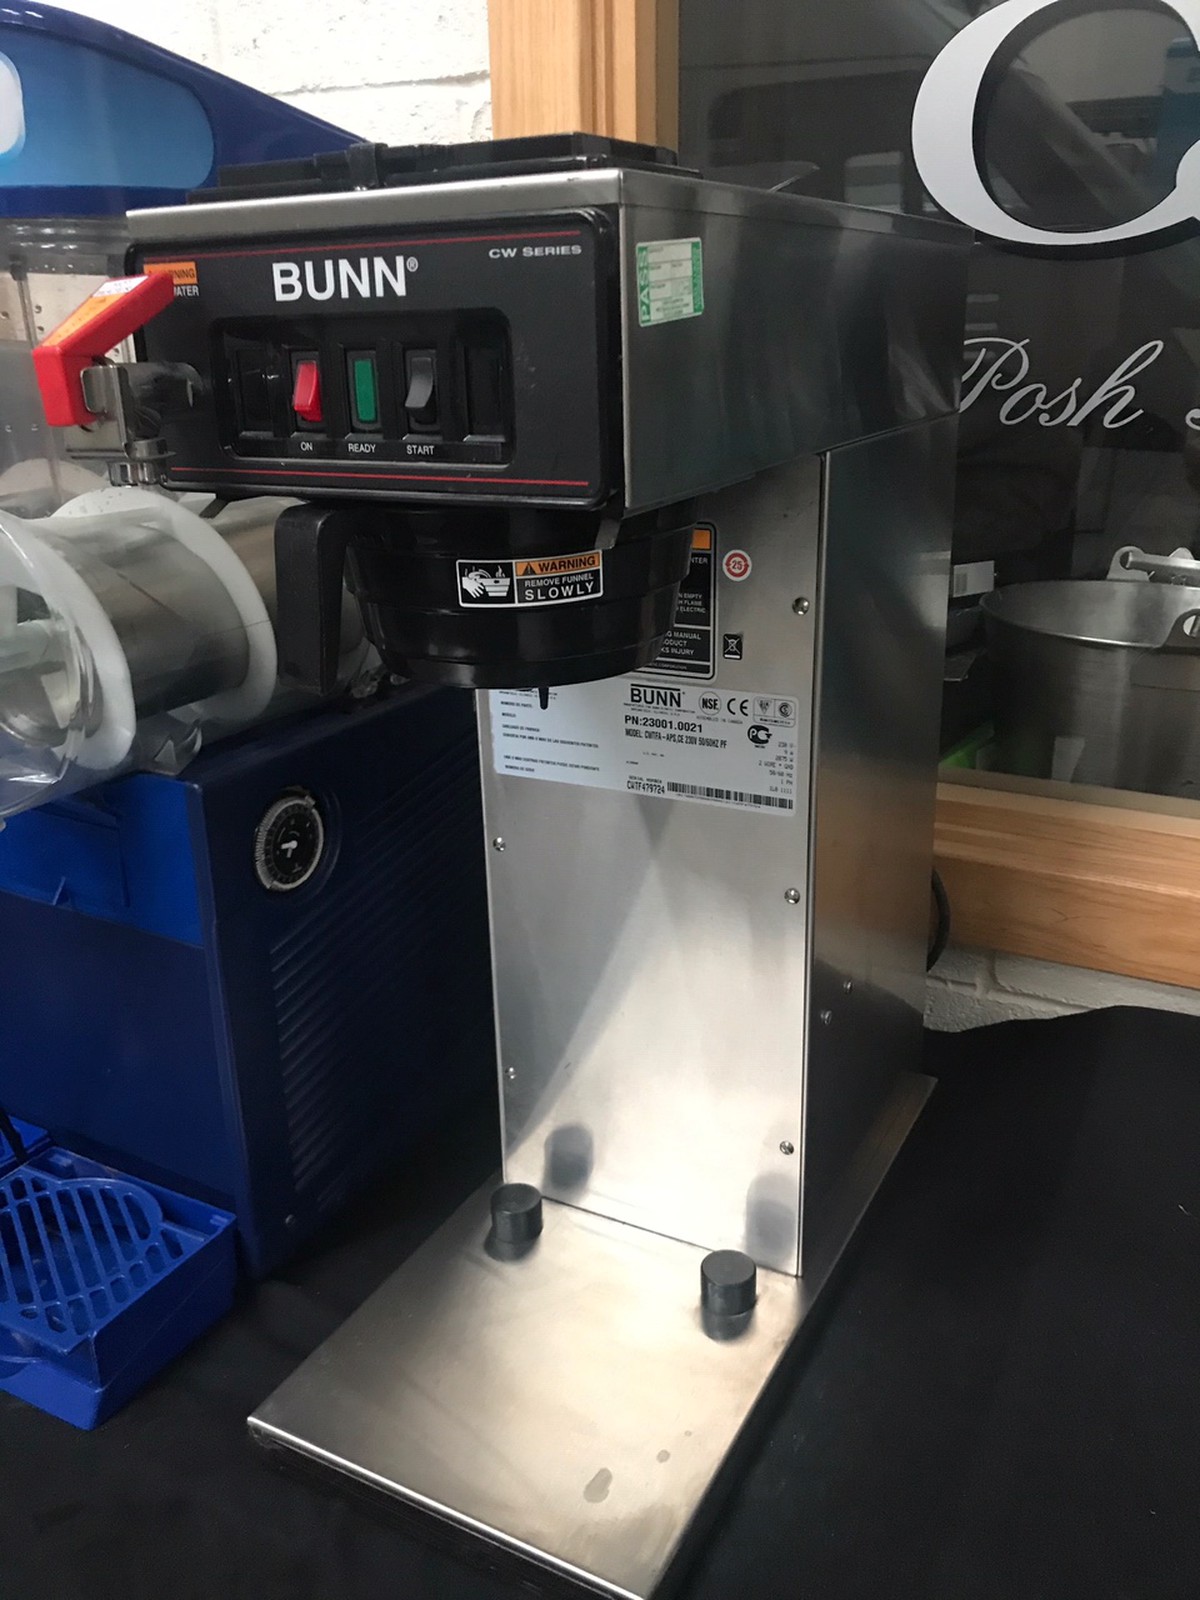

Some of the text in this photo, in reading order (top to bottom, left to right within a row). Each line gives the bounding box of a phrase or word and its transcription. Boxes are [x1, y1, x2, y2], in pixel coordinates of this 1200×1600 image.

[489, 245, 582, 259] CW SERIES
[958, 338, 1164, 429] Posh
[300, 441, 313, 452] ON
[347, 443, 377, 454] READY
[406, 444, 436, 456] START
[538, 556, 596, 573] WARNING
[731, 560, 744, 571] 25
[524, 573, 595, 588] REMOVE FUNNEL
[524, 581, 595, 601] SLOWLY
[673, 631, 702, 641] MANUAL
[663, 639, 688, 647] ODUCT
[671, 647, 695, 656] INJURY
[624, 714, 703, 733] PN:23001.0021
[720, 739, 728, 749] PF
